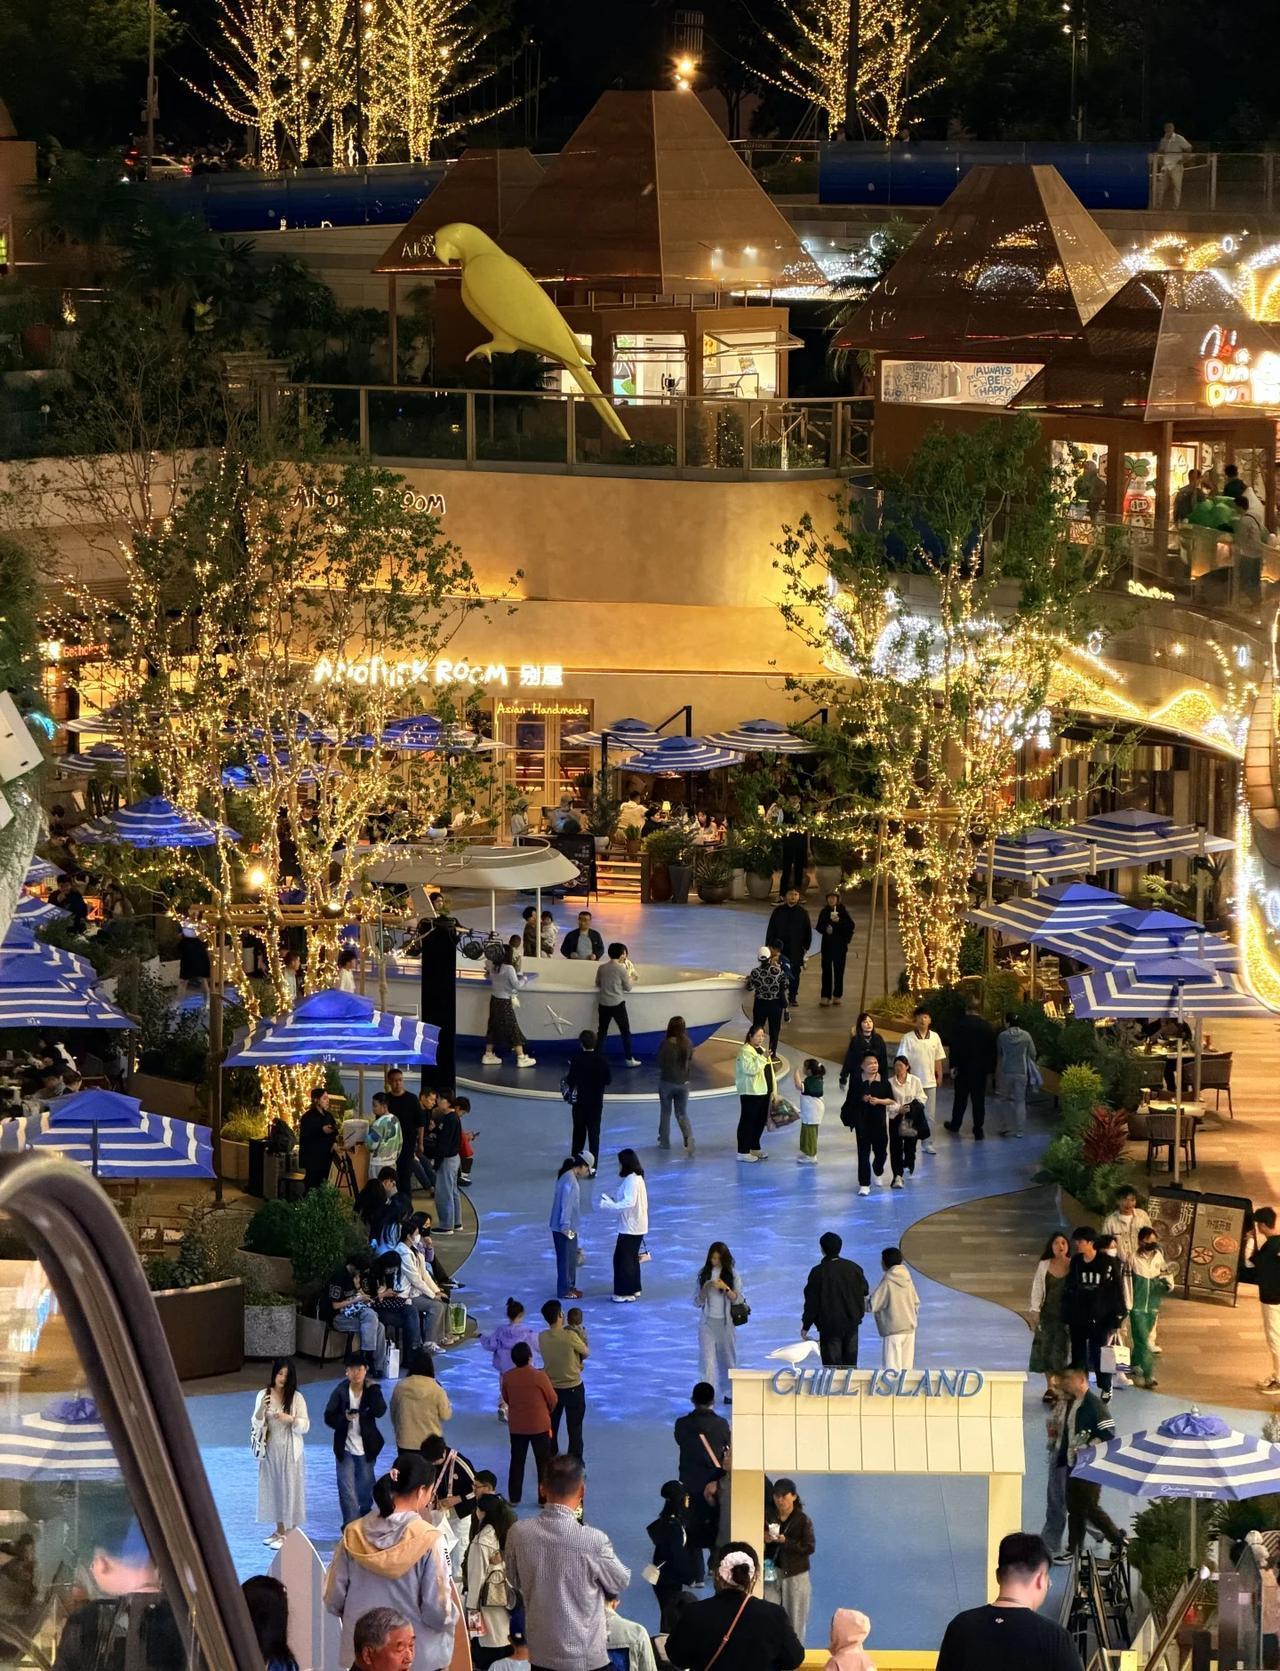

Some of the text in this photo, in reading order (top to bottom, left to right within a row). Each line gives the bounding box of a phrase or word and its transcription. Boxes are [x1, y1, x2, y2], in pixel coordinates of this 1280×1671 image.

[975, 366, 1012, 376] ALWAYS
[987, 376, 1002, 385] BE
[979, 386, 1011, 397] HAPPY
[772, 1367, 984, 1397] CHILL ISLAND
